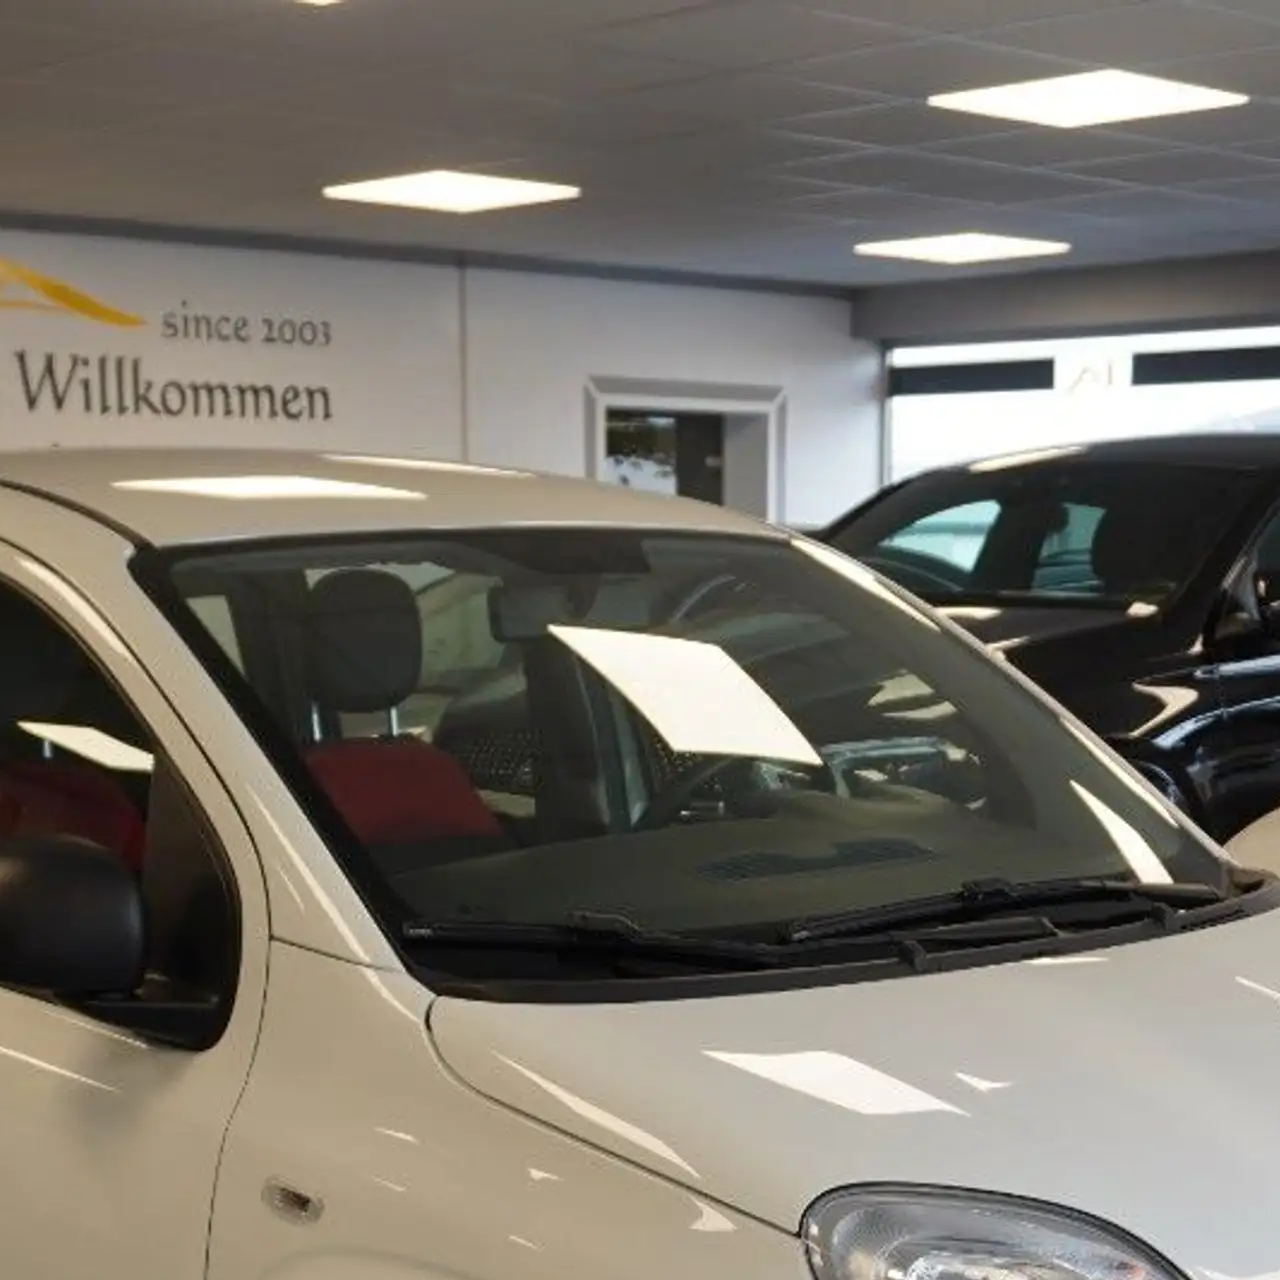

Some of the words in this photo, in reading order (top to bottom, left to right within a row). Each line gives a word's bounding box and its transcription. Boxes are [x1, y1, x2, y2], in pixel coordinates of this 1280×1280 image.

[160, 300, 251, 344] since
[260, 316, 333, 347] 2003
[15, 348, 334, 421] Willkommen
